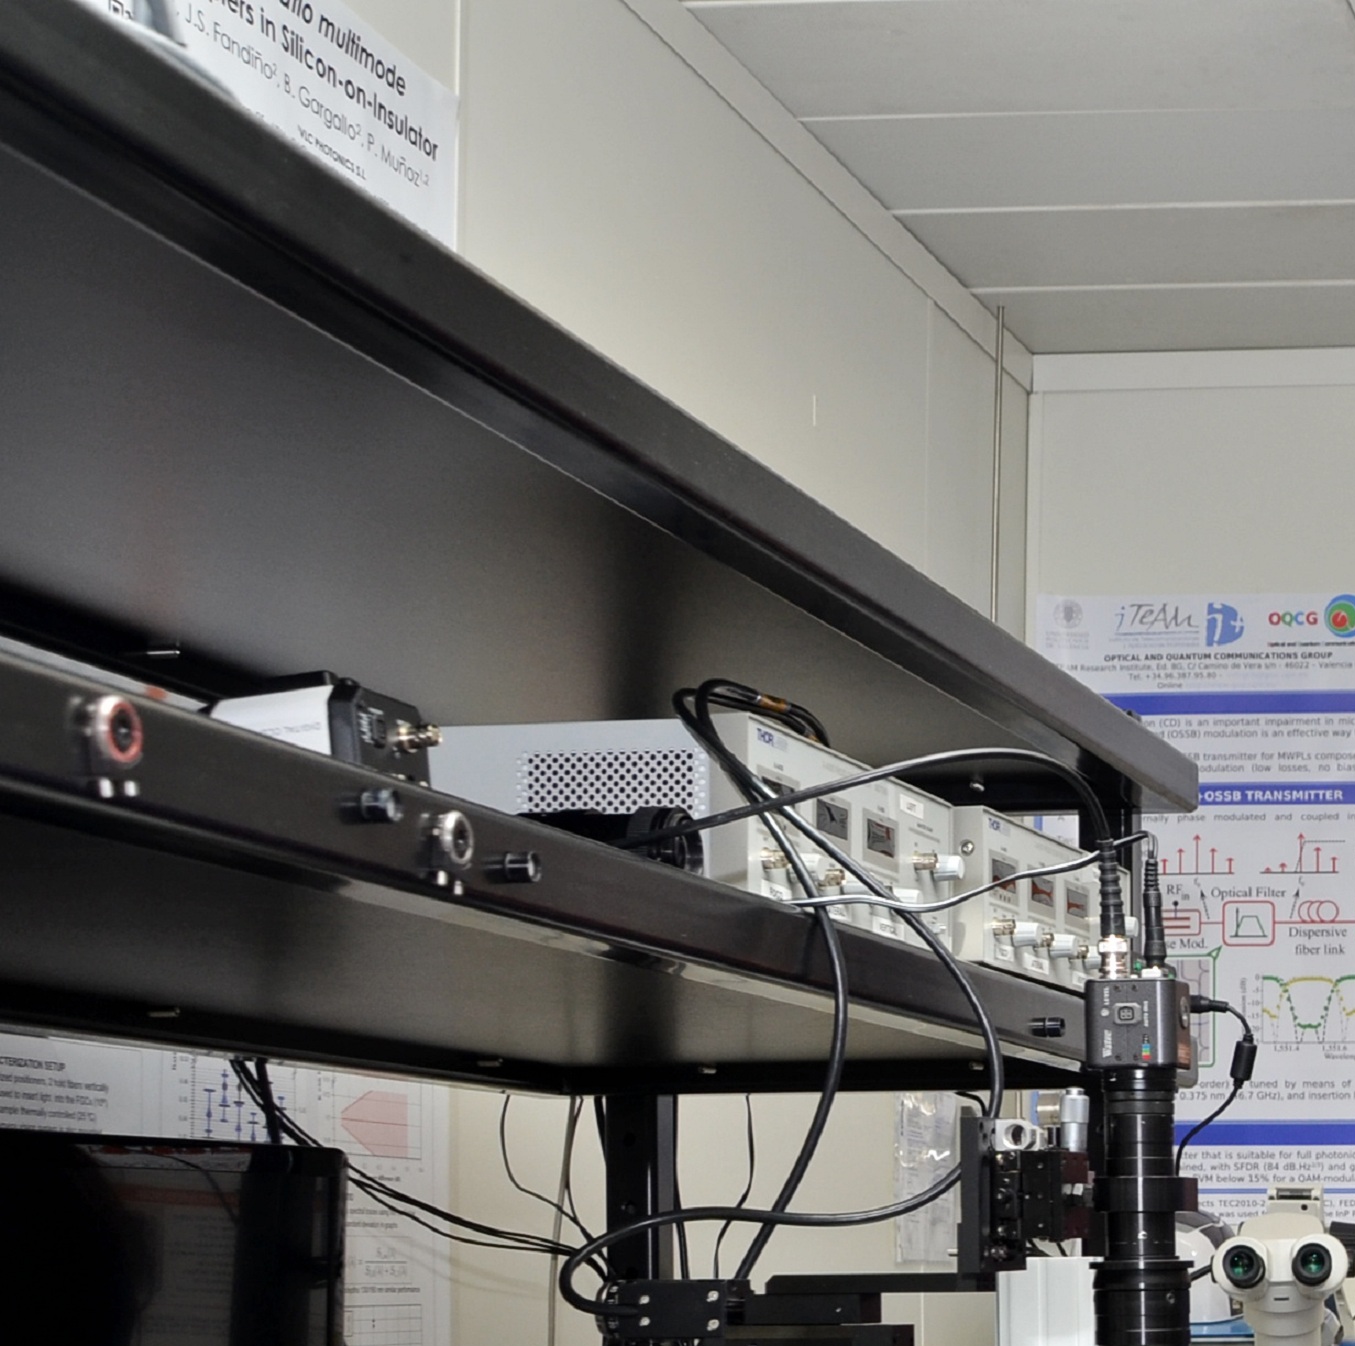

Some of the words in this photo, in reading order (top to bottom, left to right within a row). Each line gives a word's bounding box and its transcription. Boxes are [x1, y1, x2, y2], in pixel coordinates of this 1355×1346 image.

[260, 8, 276, 42] in
[319, 14, 406, 97] multimode
[284, 74, 296, 100] B.
[367, 132, 379, 157] P.
[1268, 611, 1319, 628] OQCG
[1103, 654, 1140, 662] OPTICAL
[1165, 653, 1211, 661] QUANTUM
[1213, 652, 1298, 660] COMMUNICATIONS
[1156, 681, 1182, 689] Online
[1158, 716, 1181, 728] (CD)
[1212, 716, 1260, 728] important
[1264, 715, 1320, 727] impairment
[1167, 728, 1200, 740] (OSSB)
[1203, 727, 1258, 737] modulation
[1260, 728, 1268, 737] is
[1271, 729, 1284, 737] an
[1286, 727, 1329, 737] effective
[1332, 729, 1352, 739] way
[1244, 790, 1343, 800] TRANSMITTER
[1177, 813, 1205, 823] phase
[1213, 812, 1266, 821] modulated
[1274, 812, 1292, 820] and
[1300, 812, 1340, 822] coupled
[1210, 888, 1252, 899] Optical
[1255, 888, 1286, 897] Filter
[1288, 926, 1347, 939] Dispersive
[1179, 937, 1209, 948] Mod.
[1294, 944, 1320, 954] fiber
[1323, 944, 1344, 954] link
